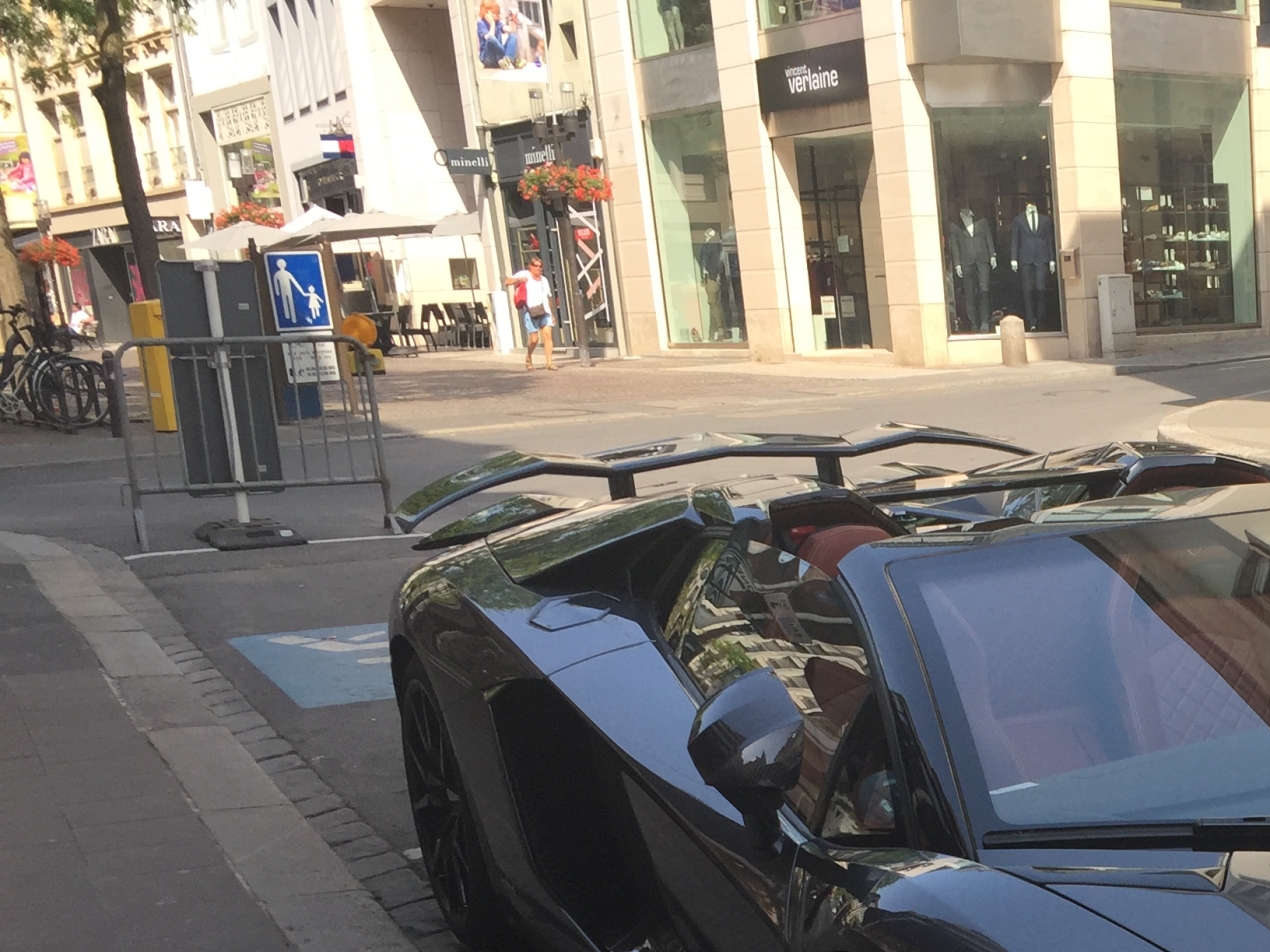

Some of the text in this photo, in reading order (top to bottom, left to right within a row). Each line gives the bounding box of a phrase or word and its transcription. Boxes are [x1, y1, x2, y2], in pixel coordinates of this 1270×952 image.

[785, 64, 807, 77] vincent
[788, 66, 838, 94] verlaine
[450, 157, 489, 167] minelli
[525, 144, 556, 165] minelli
